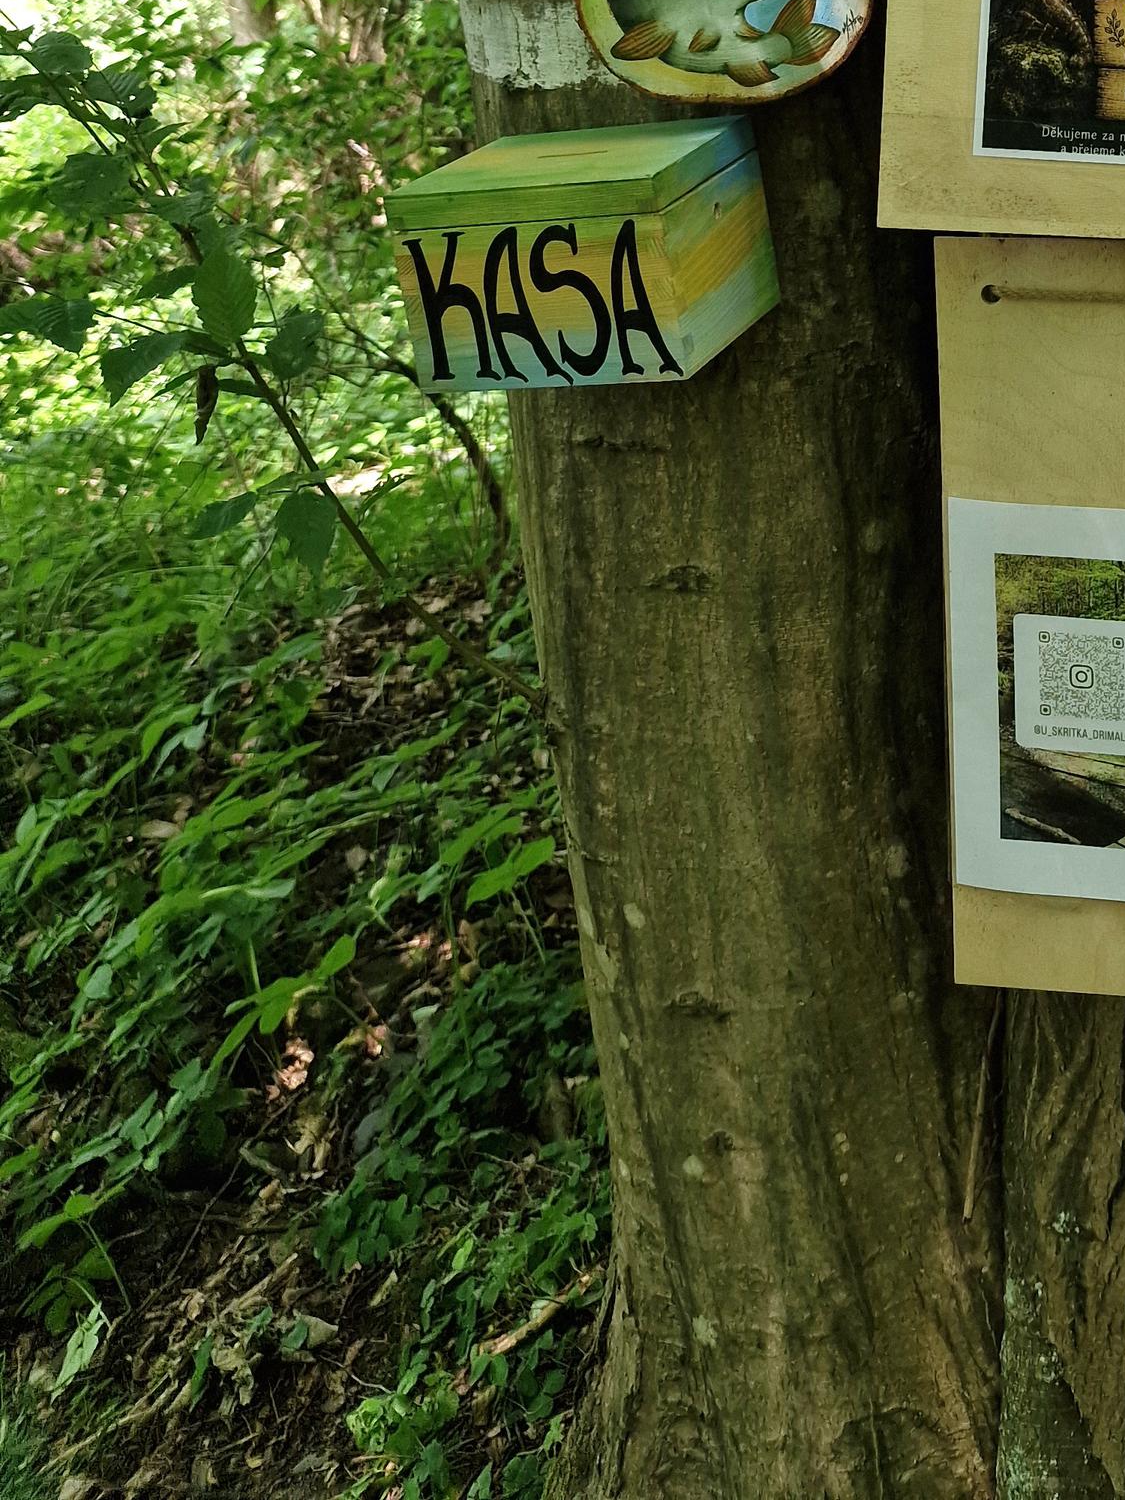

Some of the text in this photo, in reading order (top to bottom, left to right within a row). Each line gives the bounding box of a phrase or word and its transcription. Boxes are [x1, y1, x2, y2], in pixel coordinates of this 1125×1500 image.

[1041, 125, 1097, 141] Děkujeme
[1102, 132, 1115, 141] za
[1061, 145, 1067, 153] a
[401, 218, 685, 387] KASA
